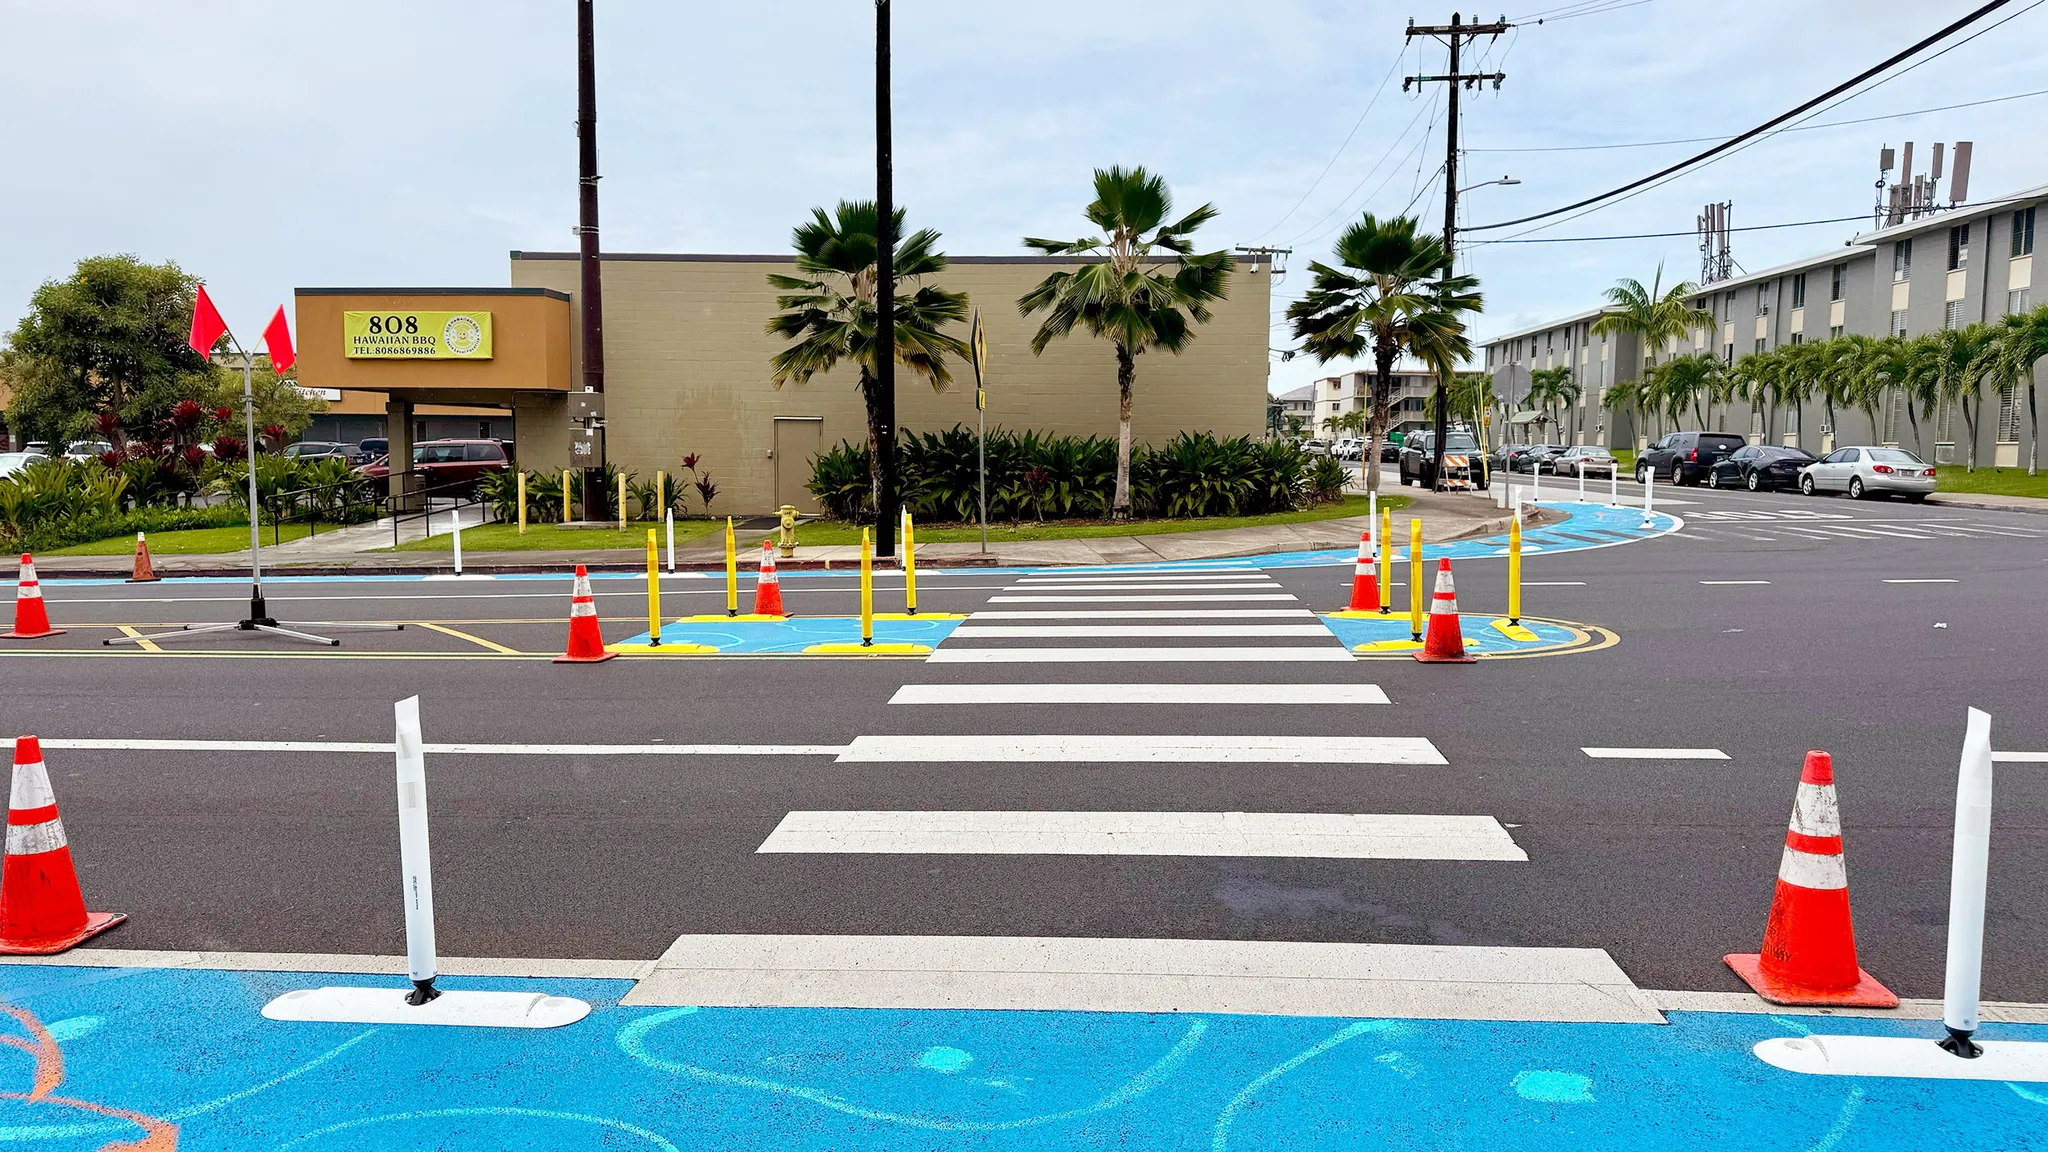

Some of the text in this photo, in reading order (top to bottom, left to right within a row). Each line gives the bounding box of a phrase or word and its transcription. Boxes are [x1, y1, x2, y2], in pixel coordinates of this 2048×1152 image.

[369, 316, 418, 334] 808
[353, 336, 436, 346] HAWAIIAN BBQ
[296, 387, 326, 396] itchen
